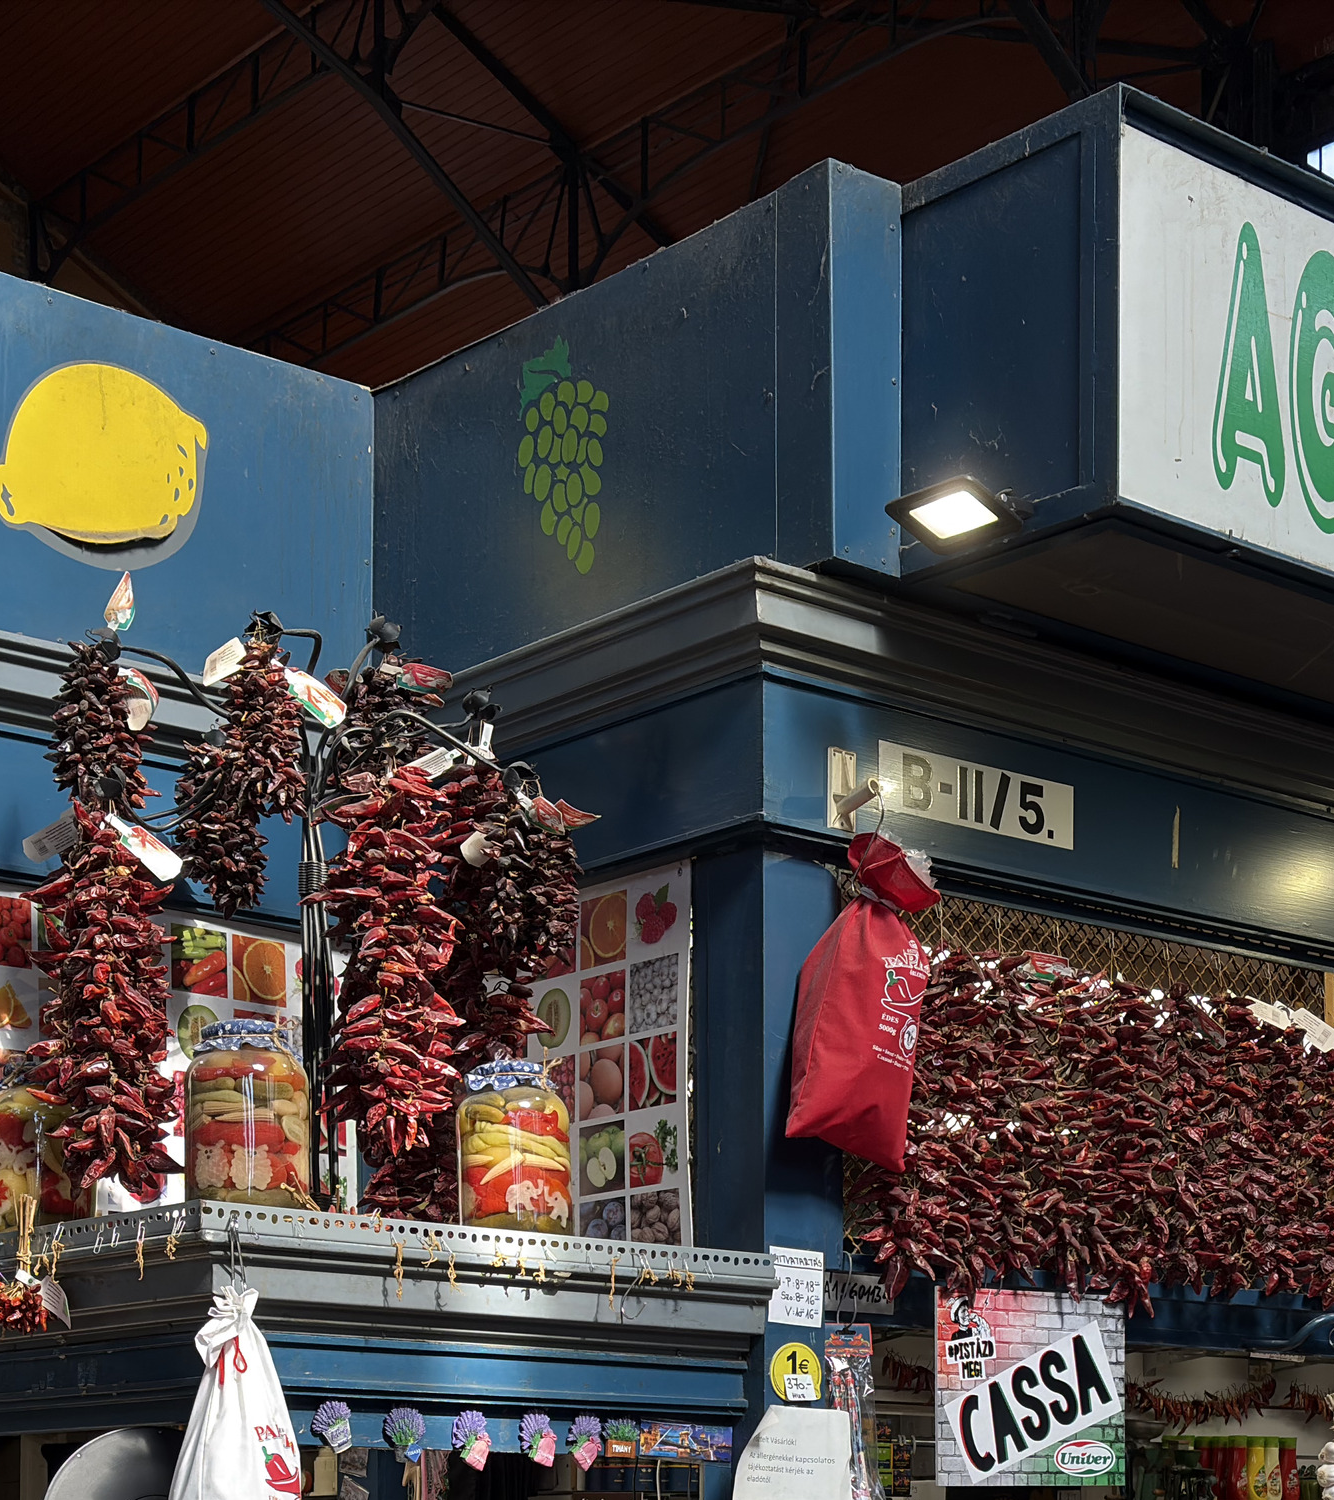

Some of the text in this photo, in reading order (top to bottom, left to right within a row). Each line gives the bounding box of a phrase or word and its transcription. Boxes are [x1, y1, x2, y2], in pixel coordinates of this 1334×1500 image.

[962, 1361, 983, 1380] MEG!
[959, 1334, 1114, 1473] CASSA
[612, 1444, 632, 1454] TIHANY
[770, 1436, 797, 1447] Vásárlók!
[749, 1451, 836, 1466] Az allergénekkel kapcsolatos
[1059, 1451, 1111, 1466] Univer
[748, 1463, 784, 1474] tájékoztatást
[785, 1466, 805, 1476] kérjék
